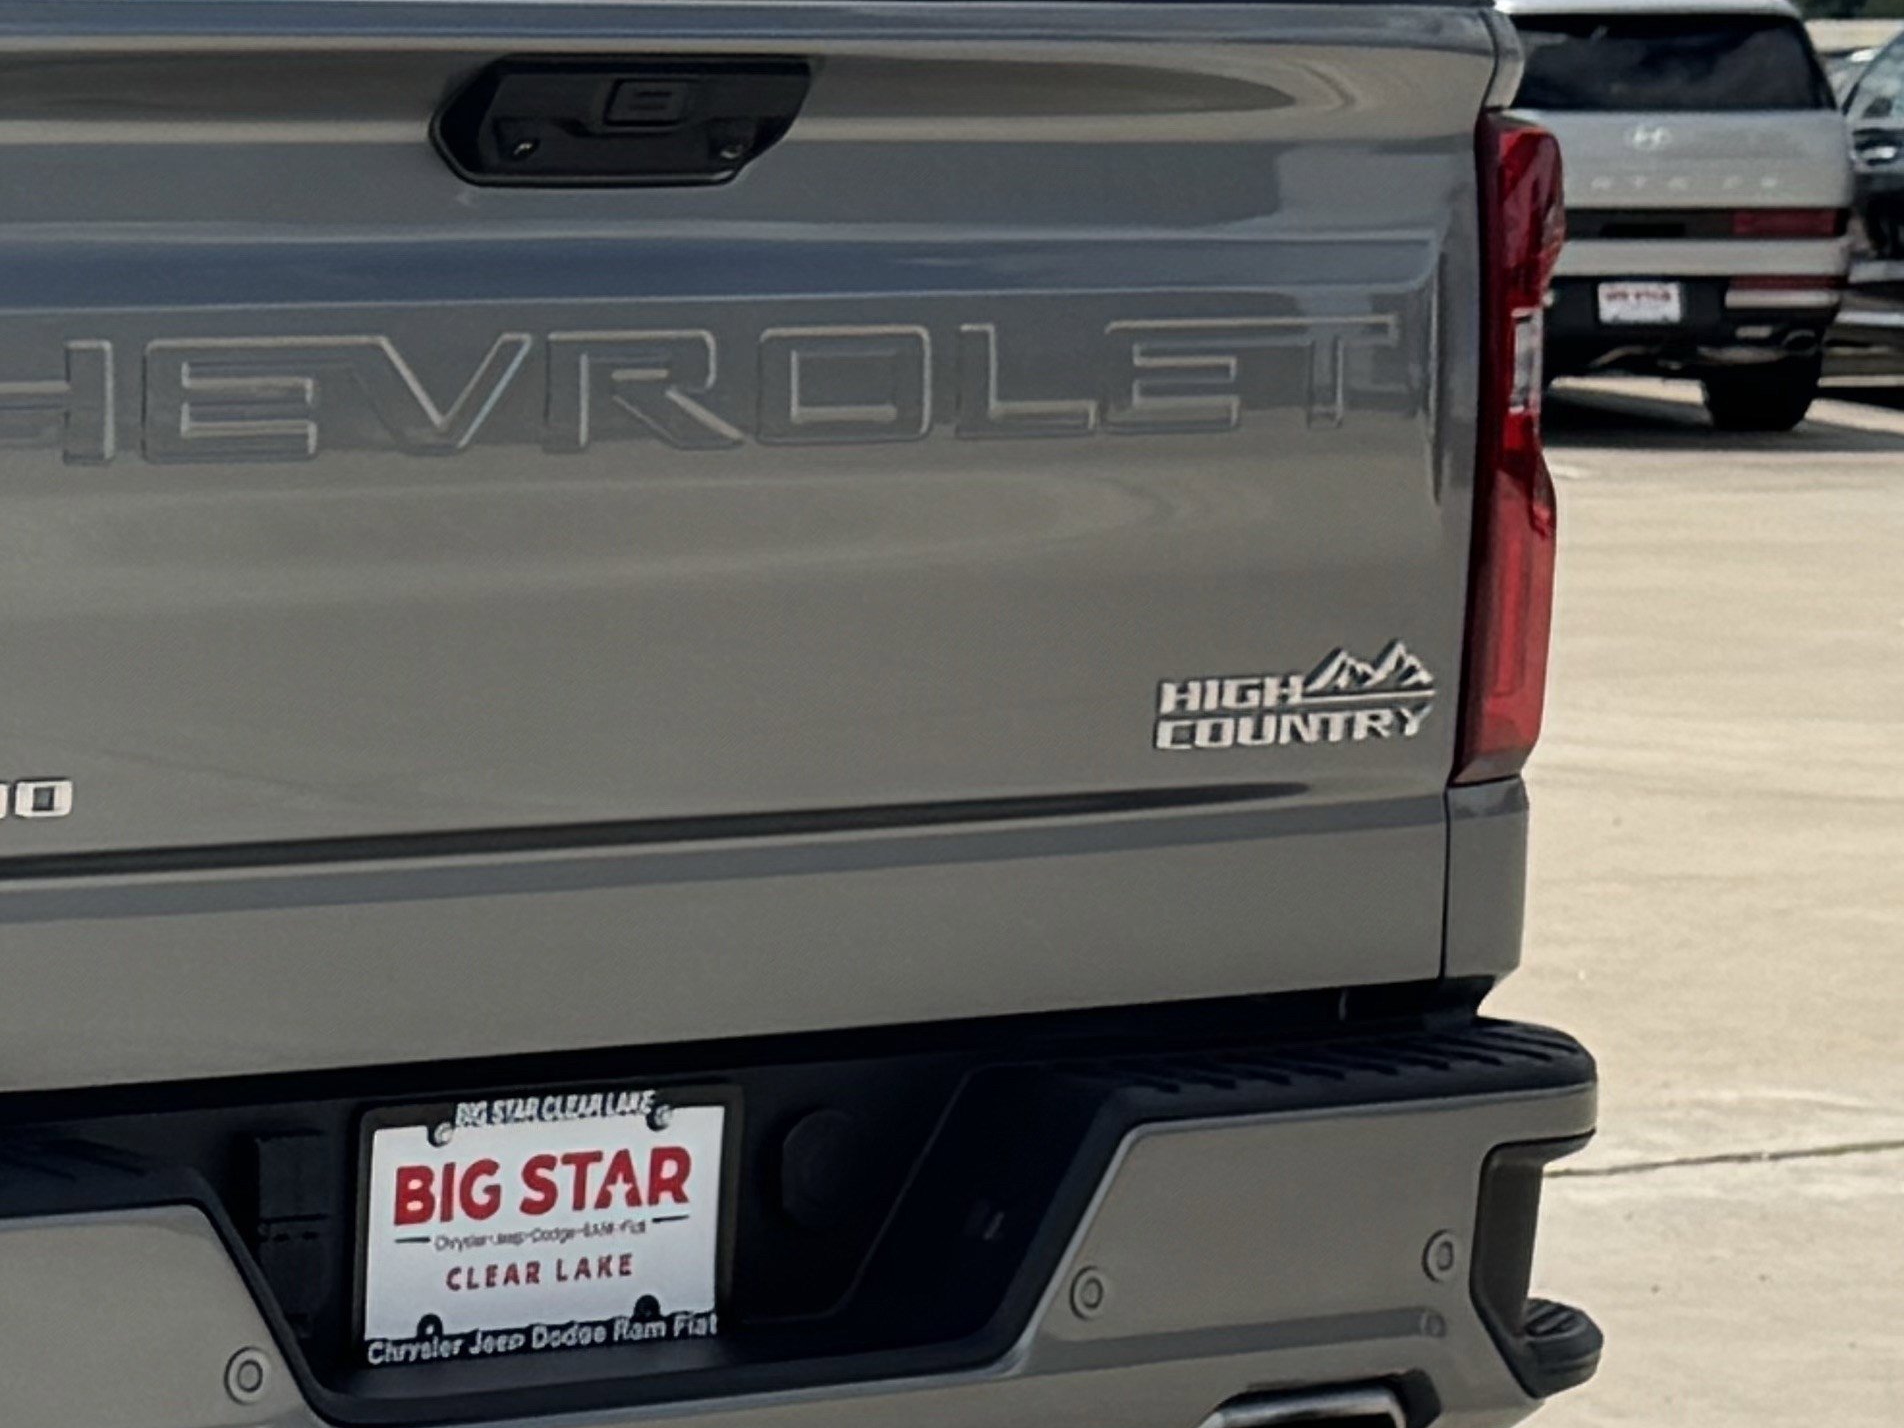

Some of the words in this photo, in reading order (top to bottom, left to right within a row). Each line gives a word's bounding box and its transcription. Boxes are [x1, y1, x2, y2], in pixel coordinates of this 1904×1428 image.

[1157, 673, 1304, 716] HIGH
[1154, 703, 1435, 750] COUNTRY
[393, 1157, 502, 1227] BIG
[519, 1145, 692, 1216] STAR
[445, 1259, 542, 1292] CLEAR
[555, 1252, 633, 1283] LAKE
[367, 1335, 465, 1366] Chrysler
[468, 1330, 526, 1356] Jeep
[531, 1323, 607, 1351] Dodge
[612, 1316, 667, 1343] Ram
[673, 1311, 719, 1340] Fiat
